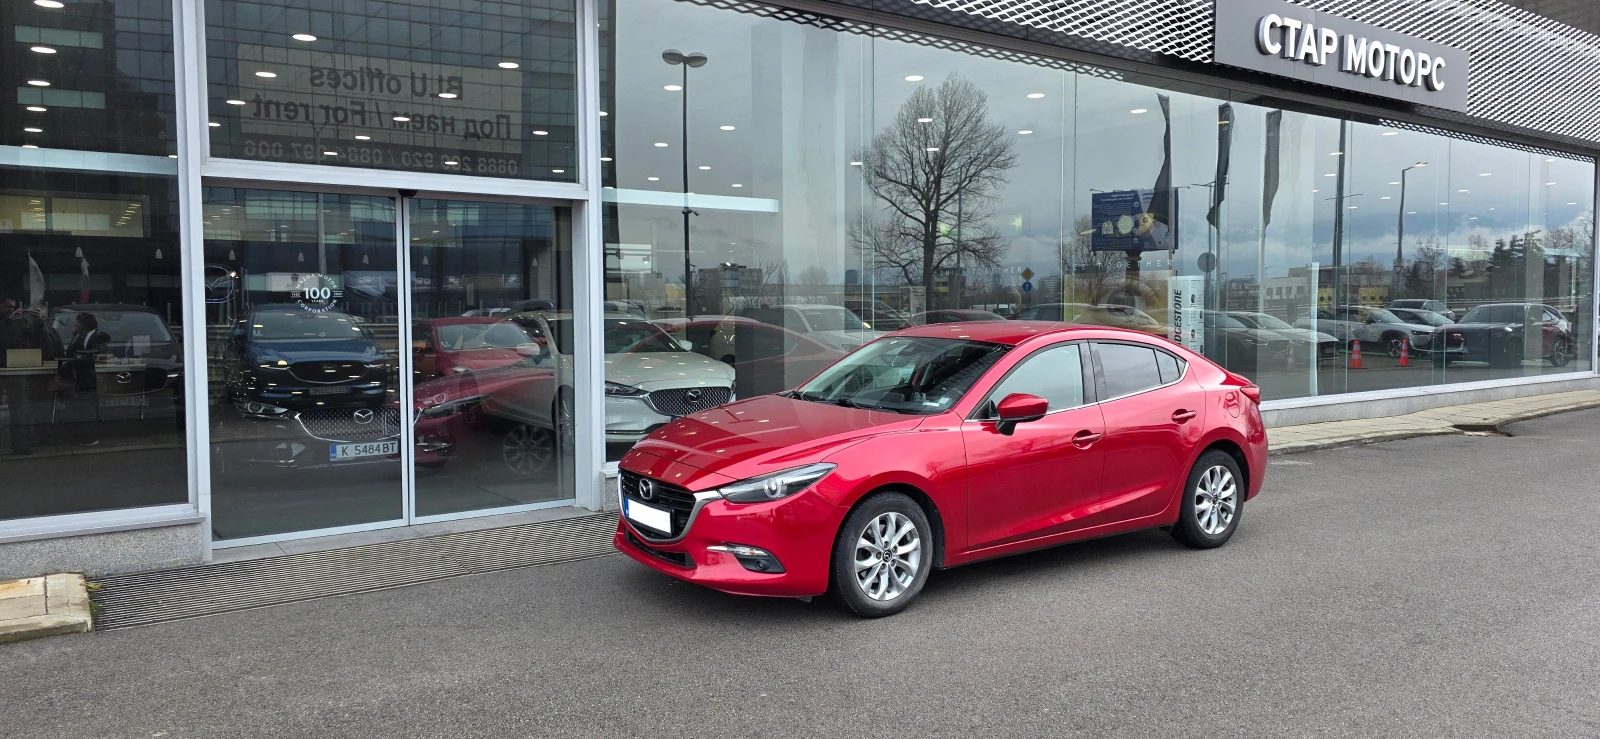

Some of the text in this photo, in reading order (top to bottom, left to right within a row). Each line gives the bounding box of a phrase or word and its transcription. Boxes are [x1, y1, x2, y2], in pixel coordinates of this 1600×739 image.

[1257, 13, 1446, 91] СТАР МОТОРС
[296, 273, 315, 289] MAZDA
[303, 287, 331, 299] 100
[298, 299, 338, 314] CORPORATION
[341, 445, 349, 457] K
[354, 443, 381, 456] 5484
[382, 442, 396, 454] BT
